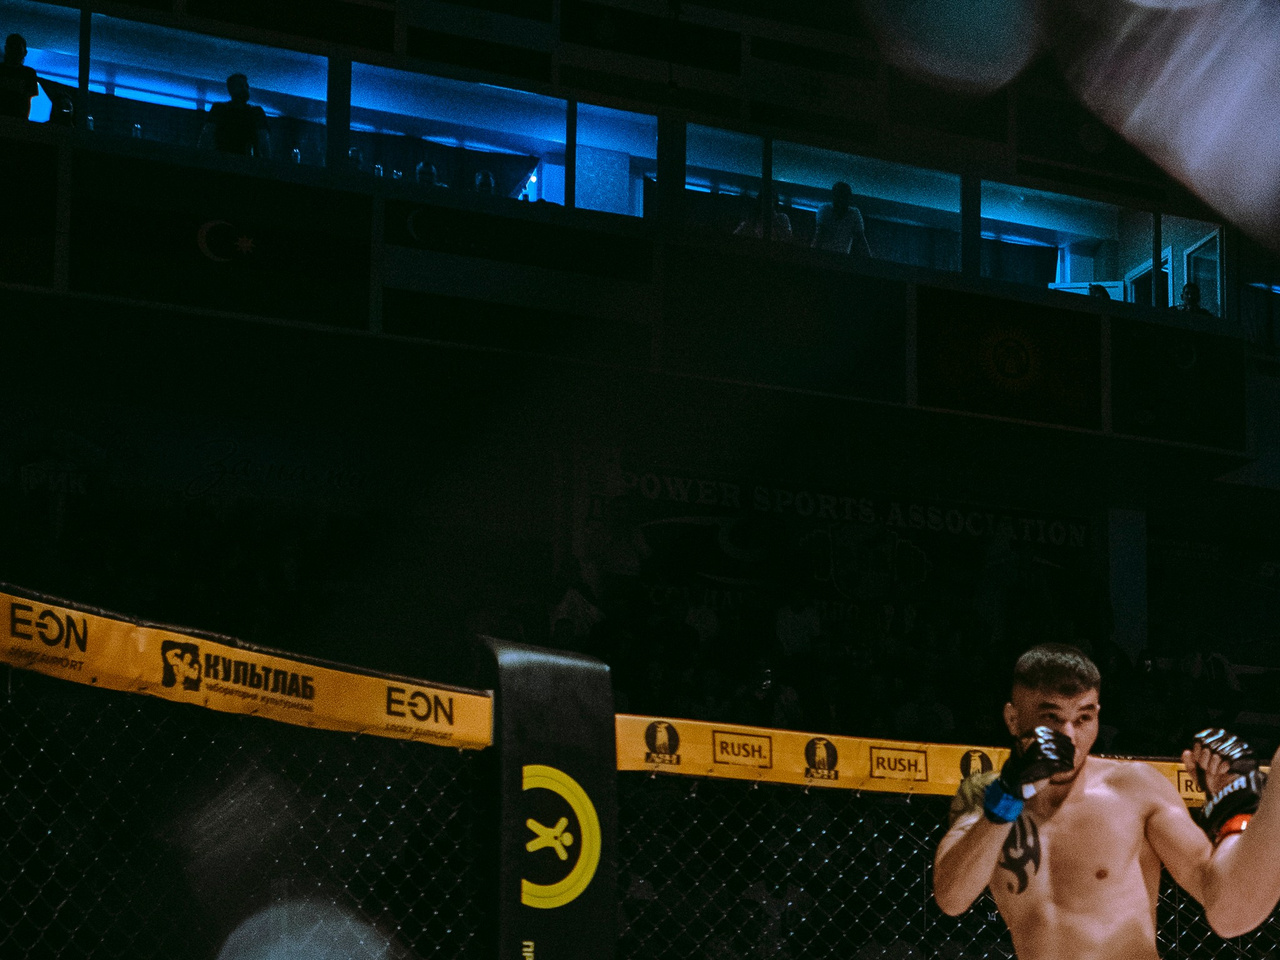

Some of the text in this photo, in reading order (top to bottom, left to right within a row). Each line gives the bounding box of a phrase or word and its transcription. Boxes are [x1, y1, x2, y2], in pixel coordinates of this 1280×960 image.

[752, 485, 877, 525] SPORTS
[885, 504, 1088, 549] ASSOCIATION
[204, 654, 315, 700] КУЛЬТЛАБ
